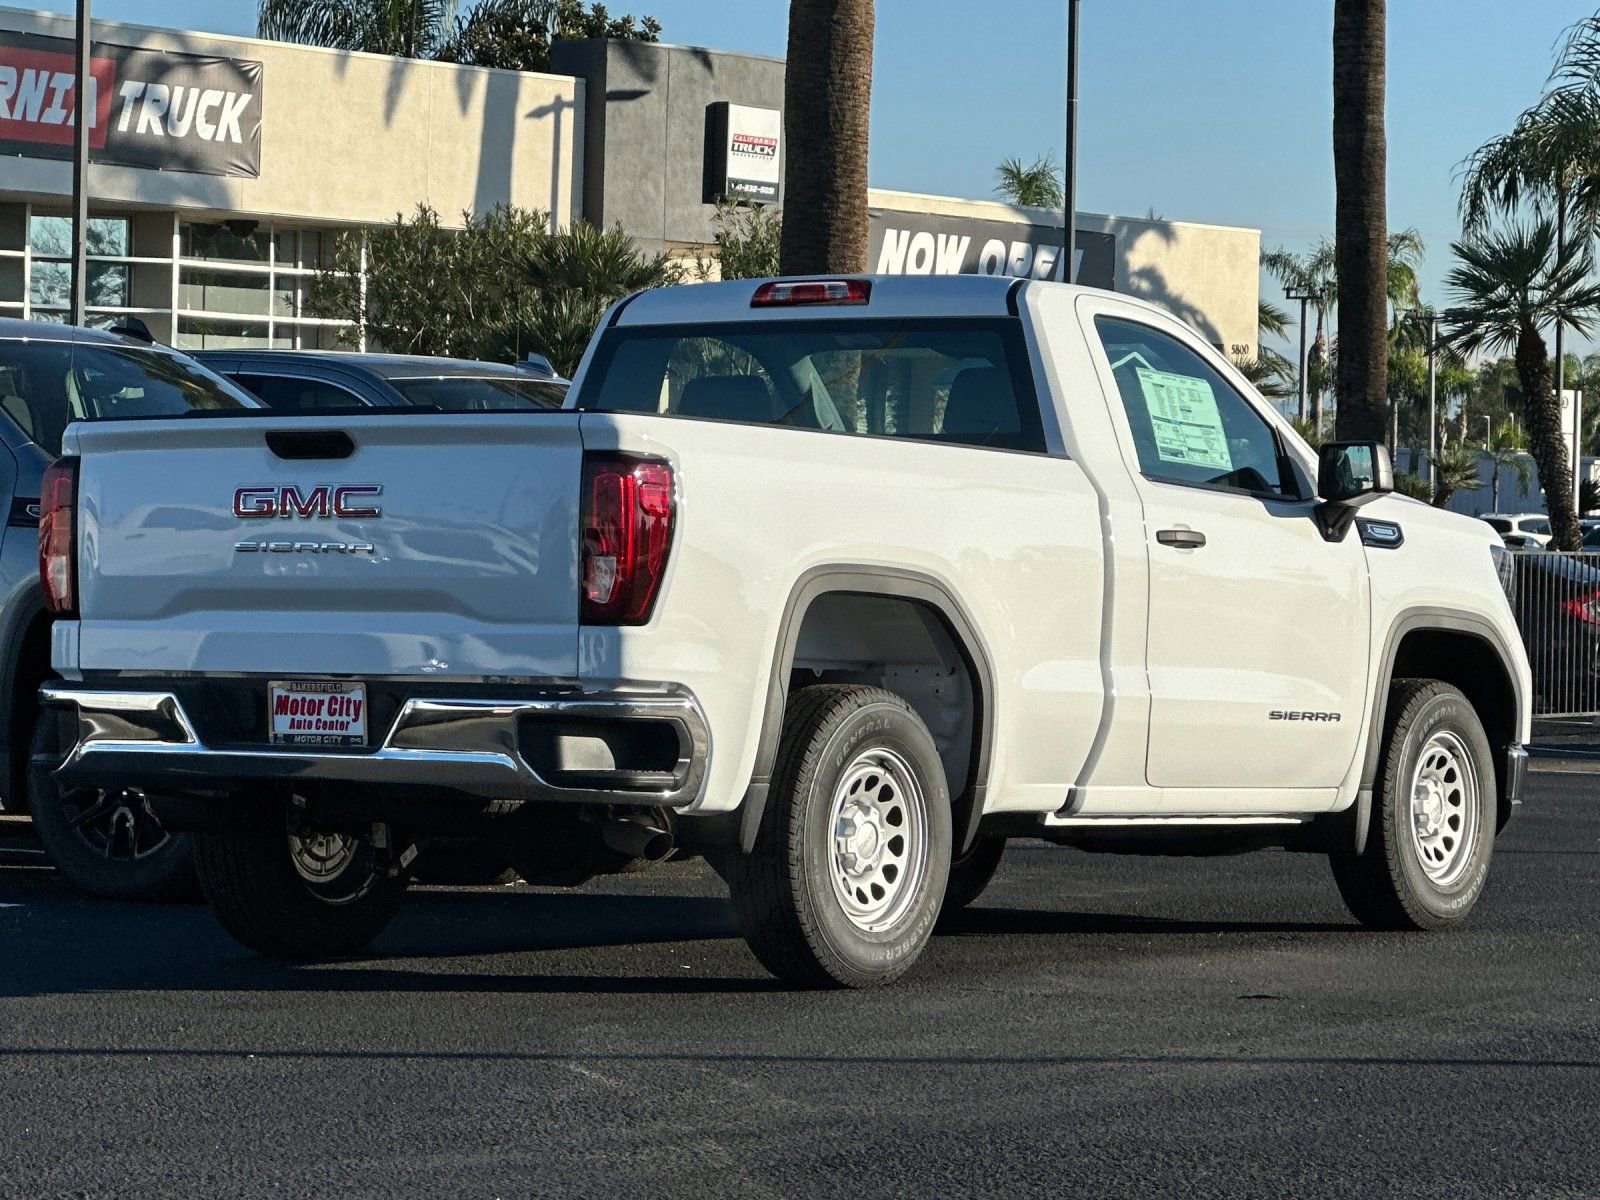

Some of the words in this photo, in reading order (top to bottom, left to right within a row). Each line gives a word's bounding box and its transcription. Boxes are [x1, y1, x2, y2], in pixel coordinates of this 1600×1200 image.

[117, 80, 253, 143] TRUCK
[734, 134, 776, 146] CALIFORNIA
[733, 142, 775, 155] TRUCK
[876, 228, 971, 275] NOW
[1231, 343, 1249, 355] 5800
[232, 484, 382, 518] GMC
[234, 541, 375, 554] SIERRA
[292, 683, 342, 691] BAKERSFIELD
[275, 694, 325, 716] Motor
[327, 695, 362, 722] City
[1269, 710, 1341, 722] SIERRA
[289, 717, 313, 730] Auto
[315, 718, 350, 731] Center
[294, 735, 322, 744] MOTOR
[323, 735, 342, 744] CITY
[836, 718, 892, 768] GENERAL
